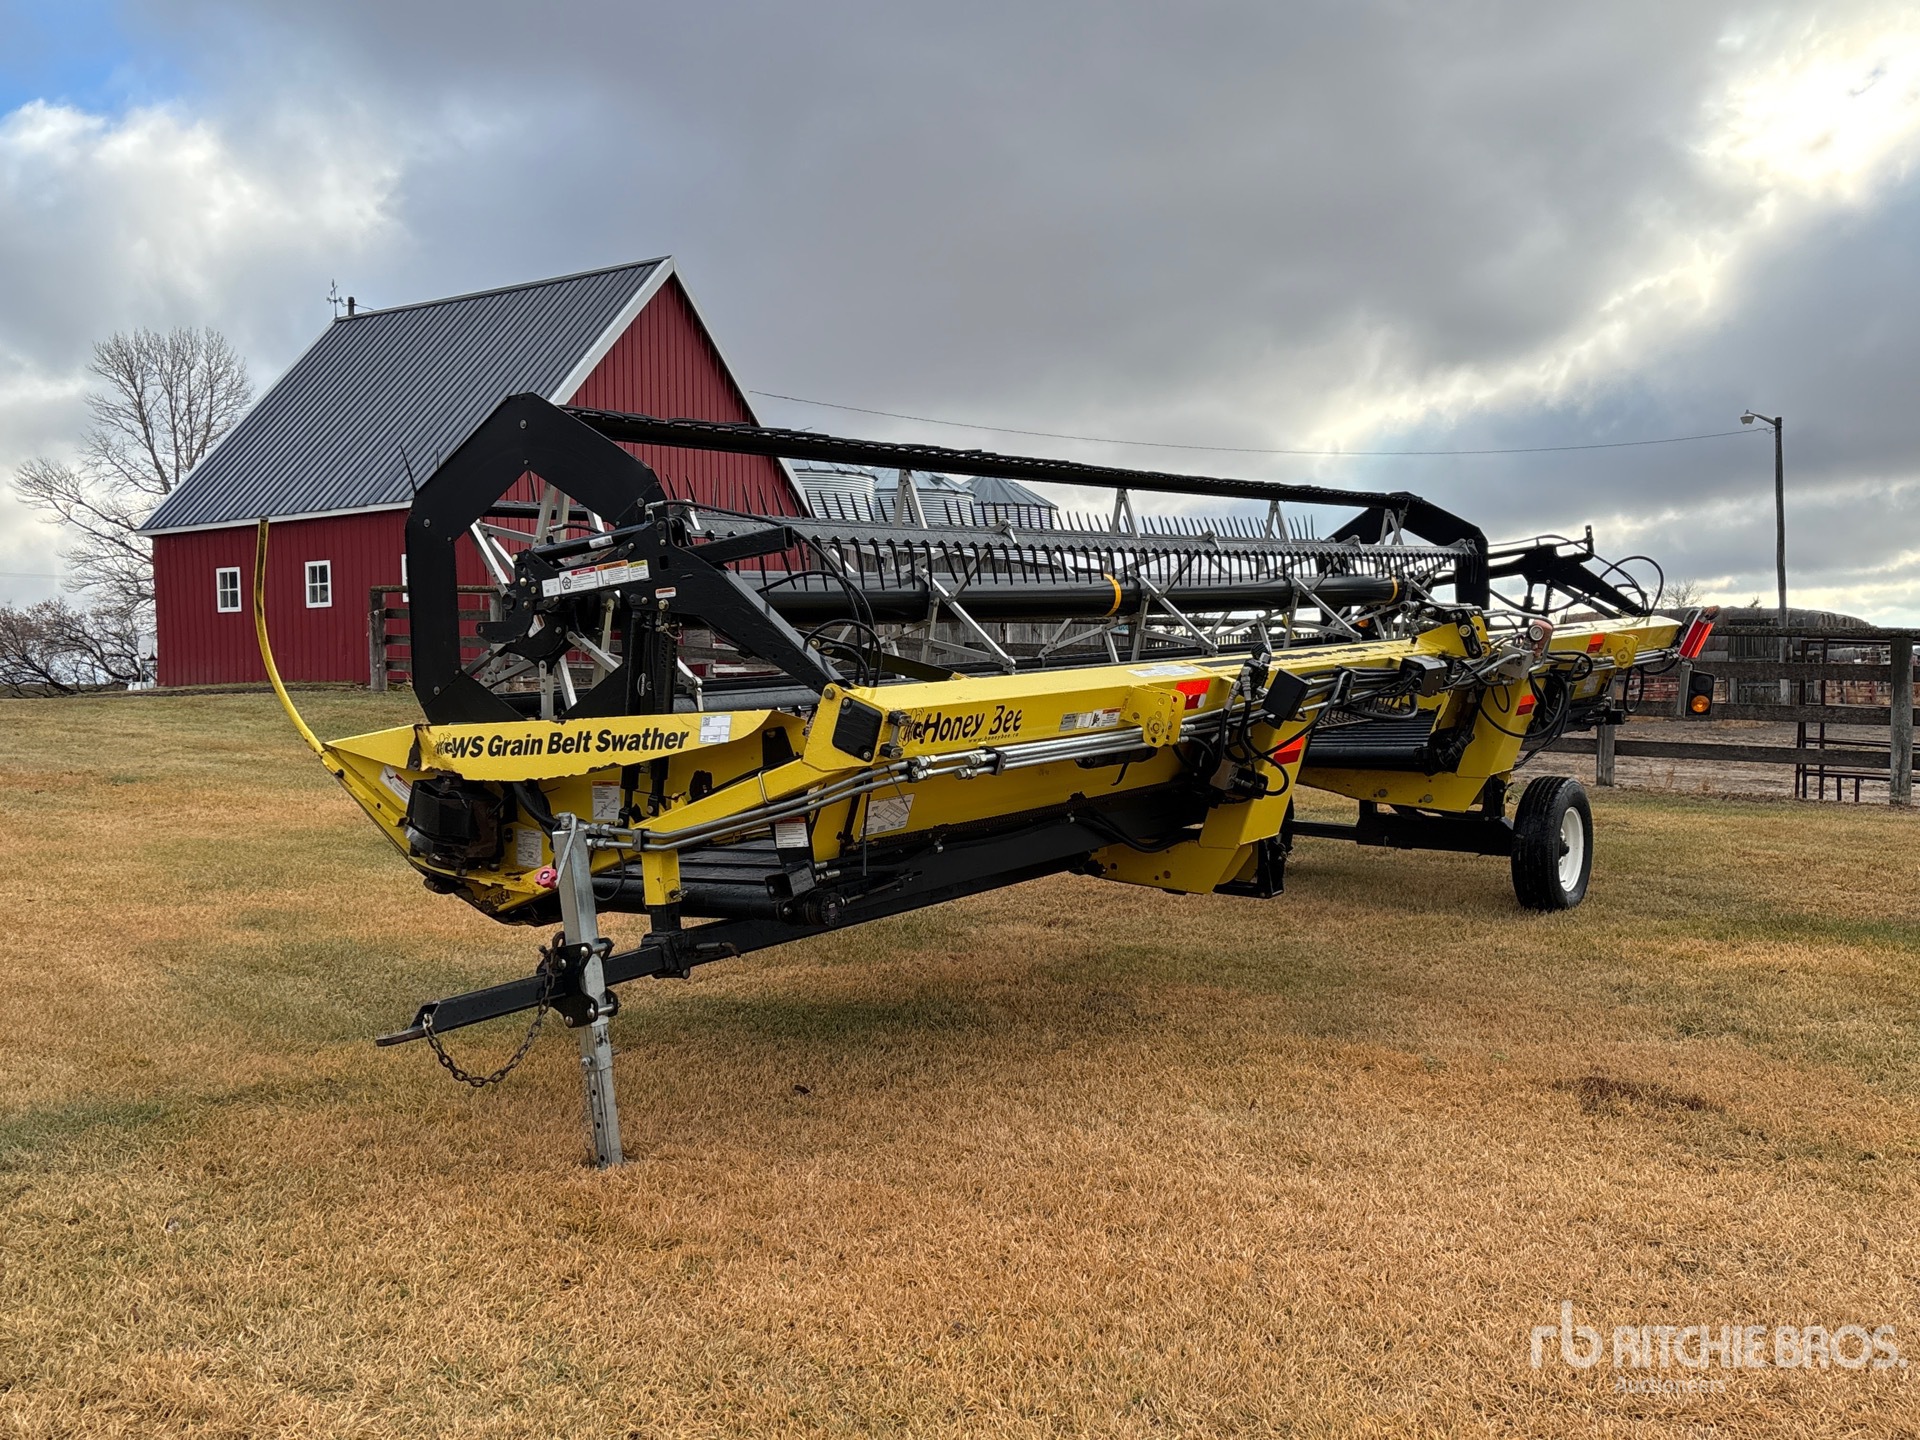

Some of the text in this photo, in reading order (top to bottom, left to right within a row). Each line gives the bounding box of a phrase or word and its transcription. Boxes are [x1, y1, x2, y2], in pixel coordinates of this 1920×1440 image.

[919, 711, 985, 744] Honey
[989, 705, 1023, 735] Bee
[451, 735, 485, 759] WS
[487, 733, 544, 757] Grain
[547, 731, 592, 754] Belt
[595, 728, 690, 753] Swather
